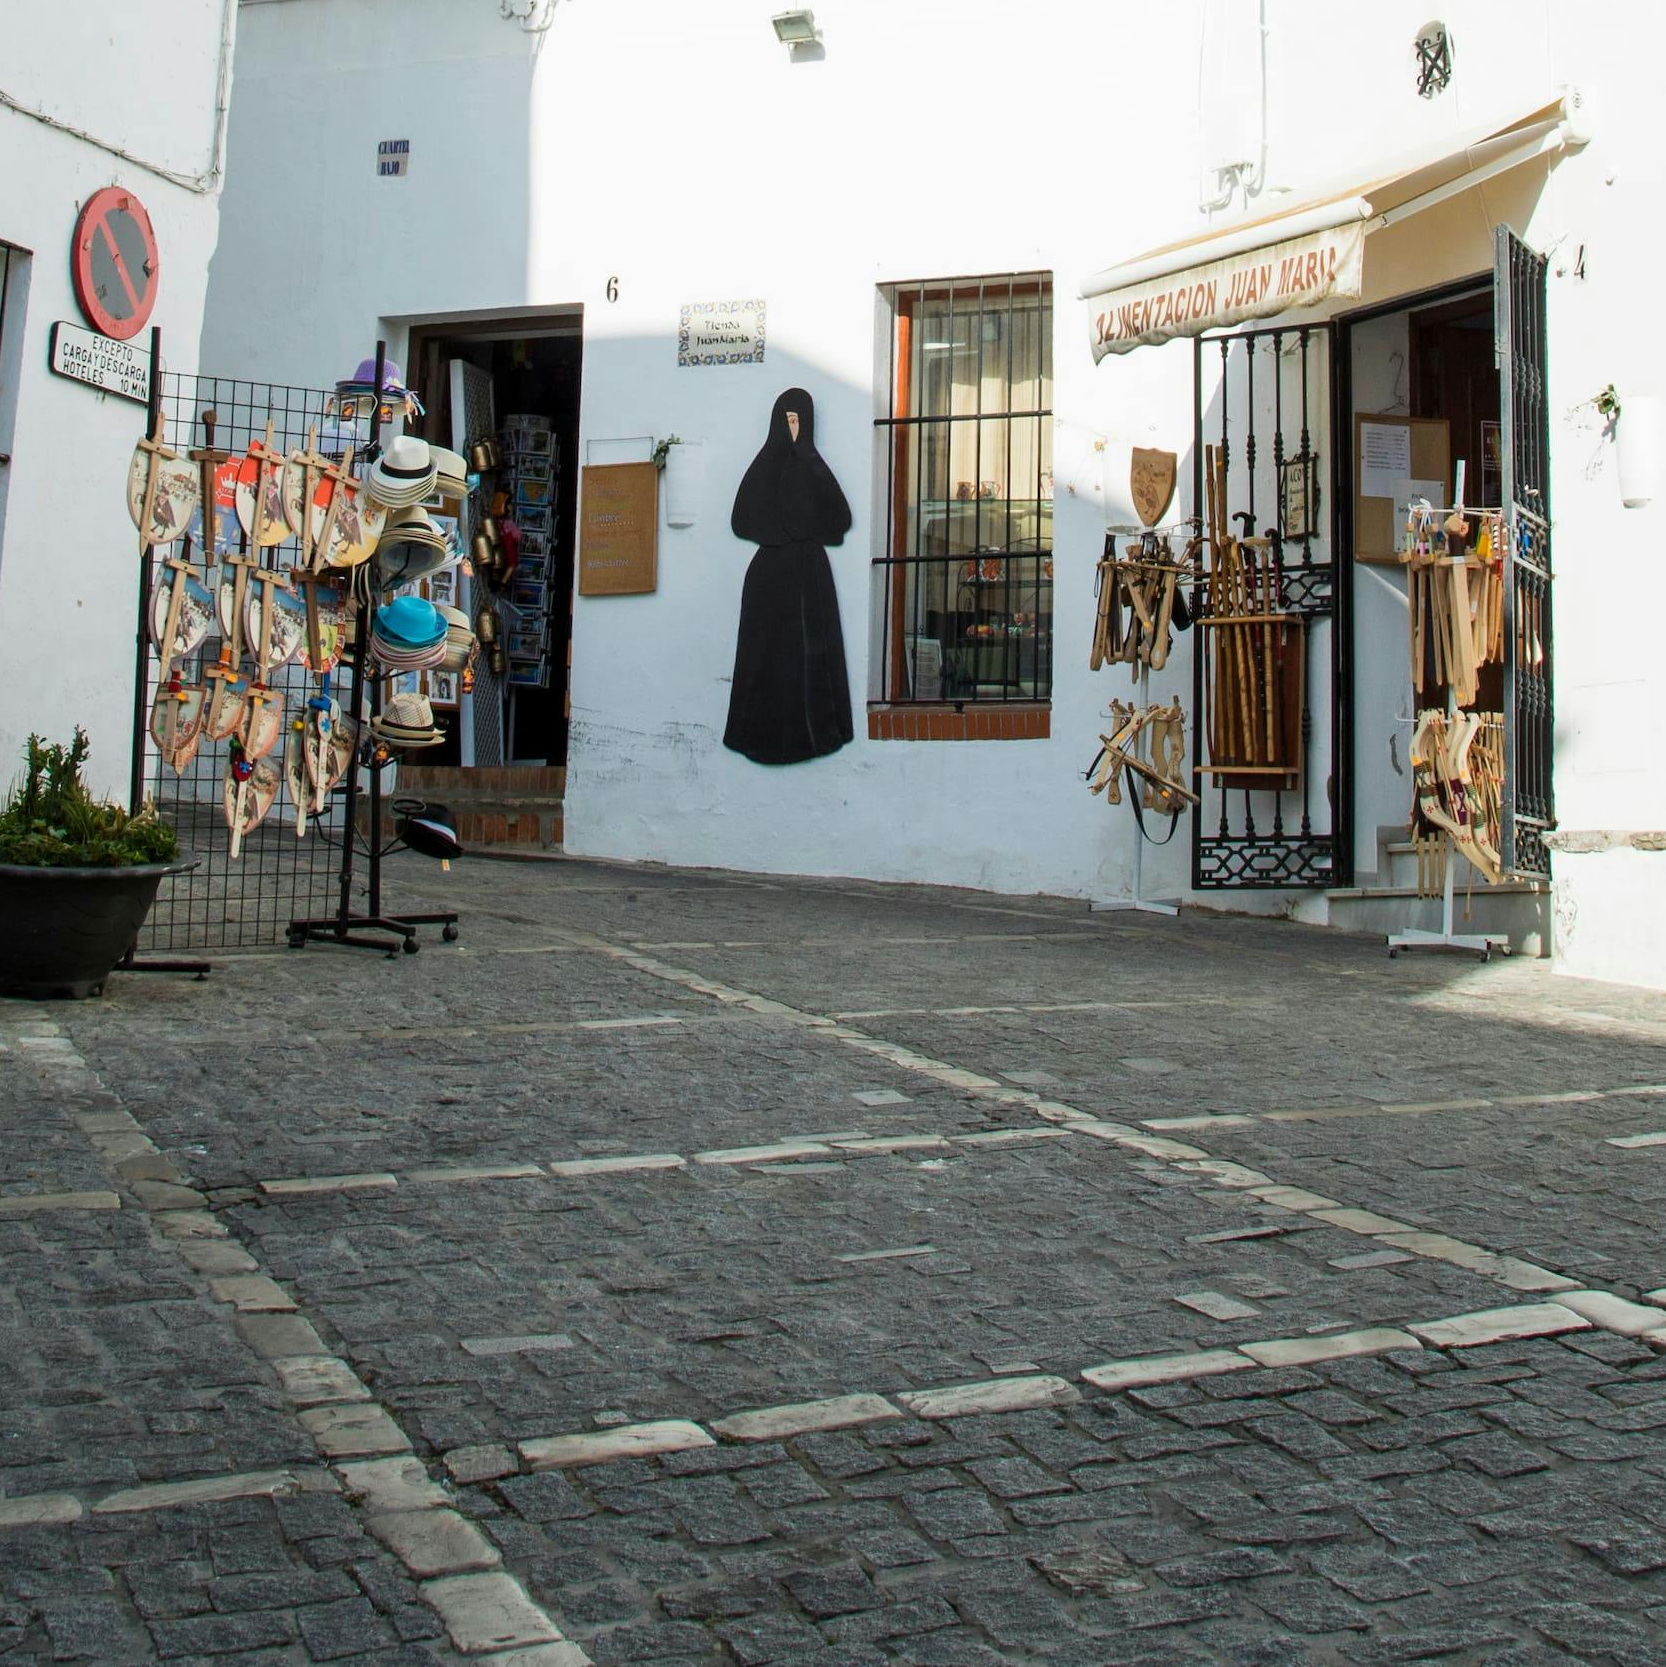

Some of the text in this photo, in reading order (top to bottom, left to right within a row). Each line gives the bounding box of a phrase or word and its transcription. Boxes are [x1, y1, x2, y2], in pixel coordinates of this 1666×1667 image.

[1574, 244, 1585, 280] 4
[606, 276, 619, 303] 6
[1096, 246, 1337, 346] ALIMENTACION JUAN MARIA
[704, 319, 740, 331] Tienda
[63, 342, 93, 368] CARGA
[100, 355, 147, 384] DESCARGA
[92, 336, 134, 363] EXCEPTO
[63, 358, 148, 400] HOTELES 10 MIN
